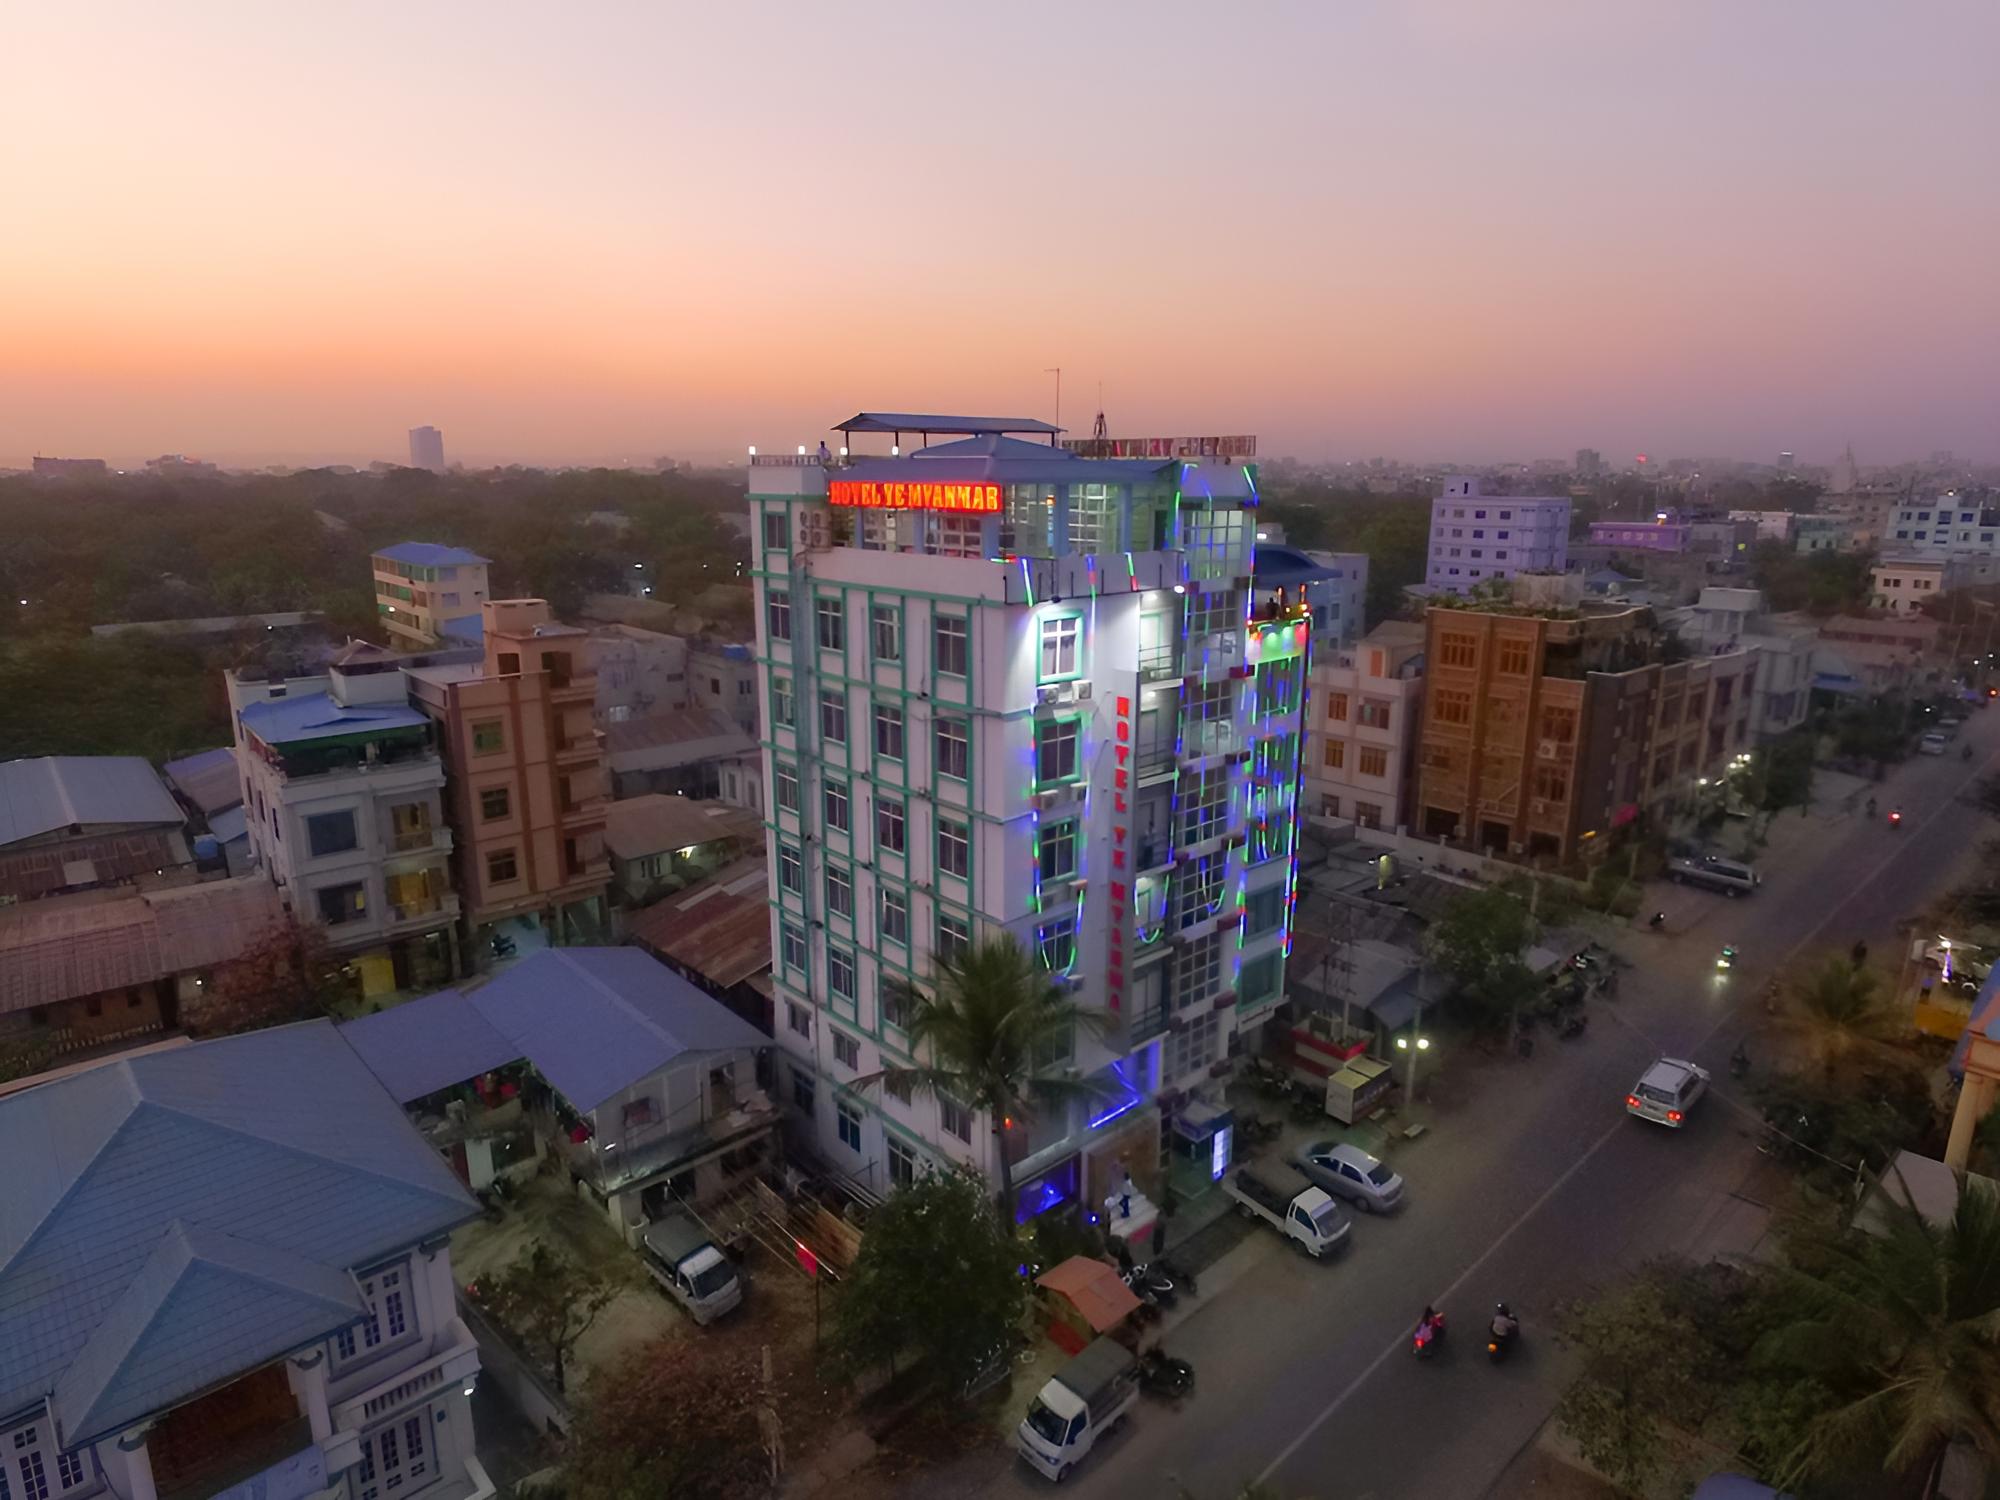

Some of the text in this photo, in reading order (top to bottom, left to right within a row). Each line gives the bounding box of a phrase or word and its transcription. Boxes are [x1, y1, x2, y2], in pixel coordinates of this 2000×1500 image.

[830, 481, 999, 510] HOTEL YE MYANMAR
[1114, 696, 1130, 813] HOTEL
[1108, 880, 1126, 1012] MYANMA
